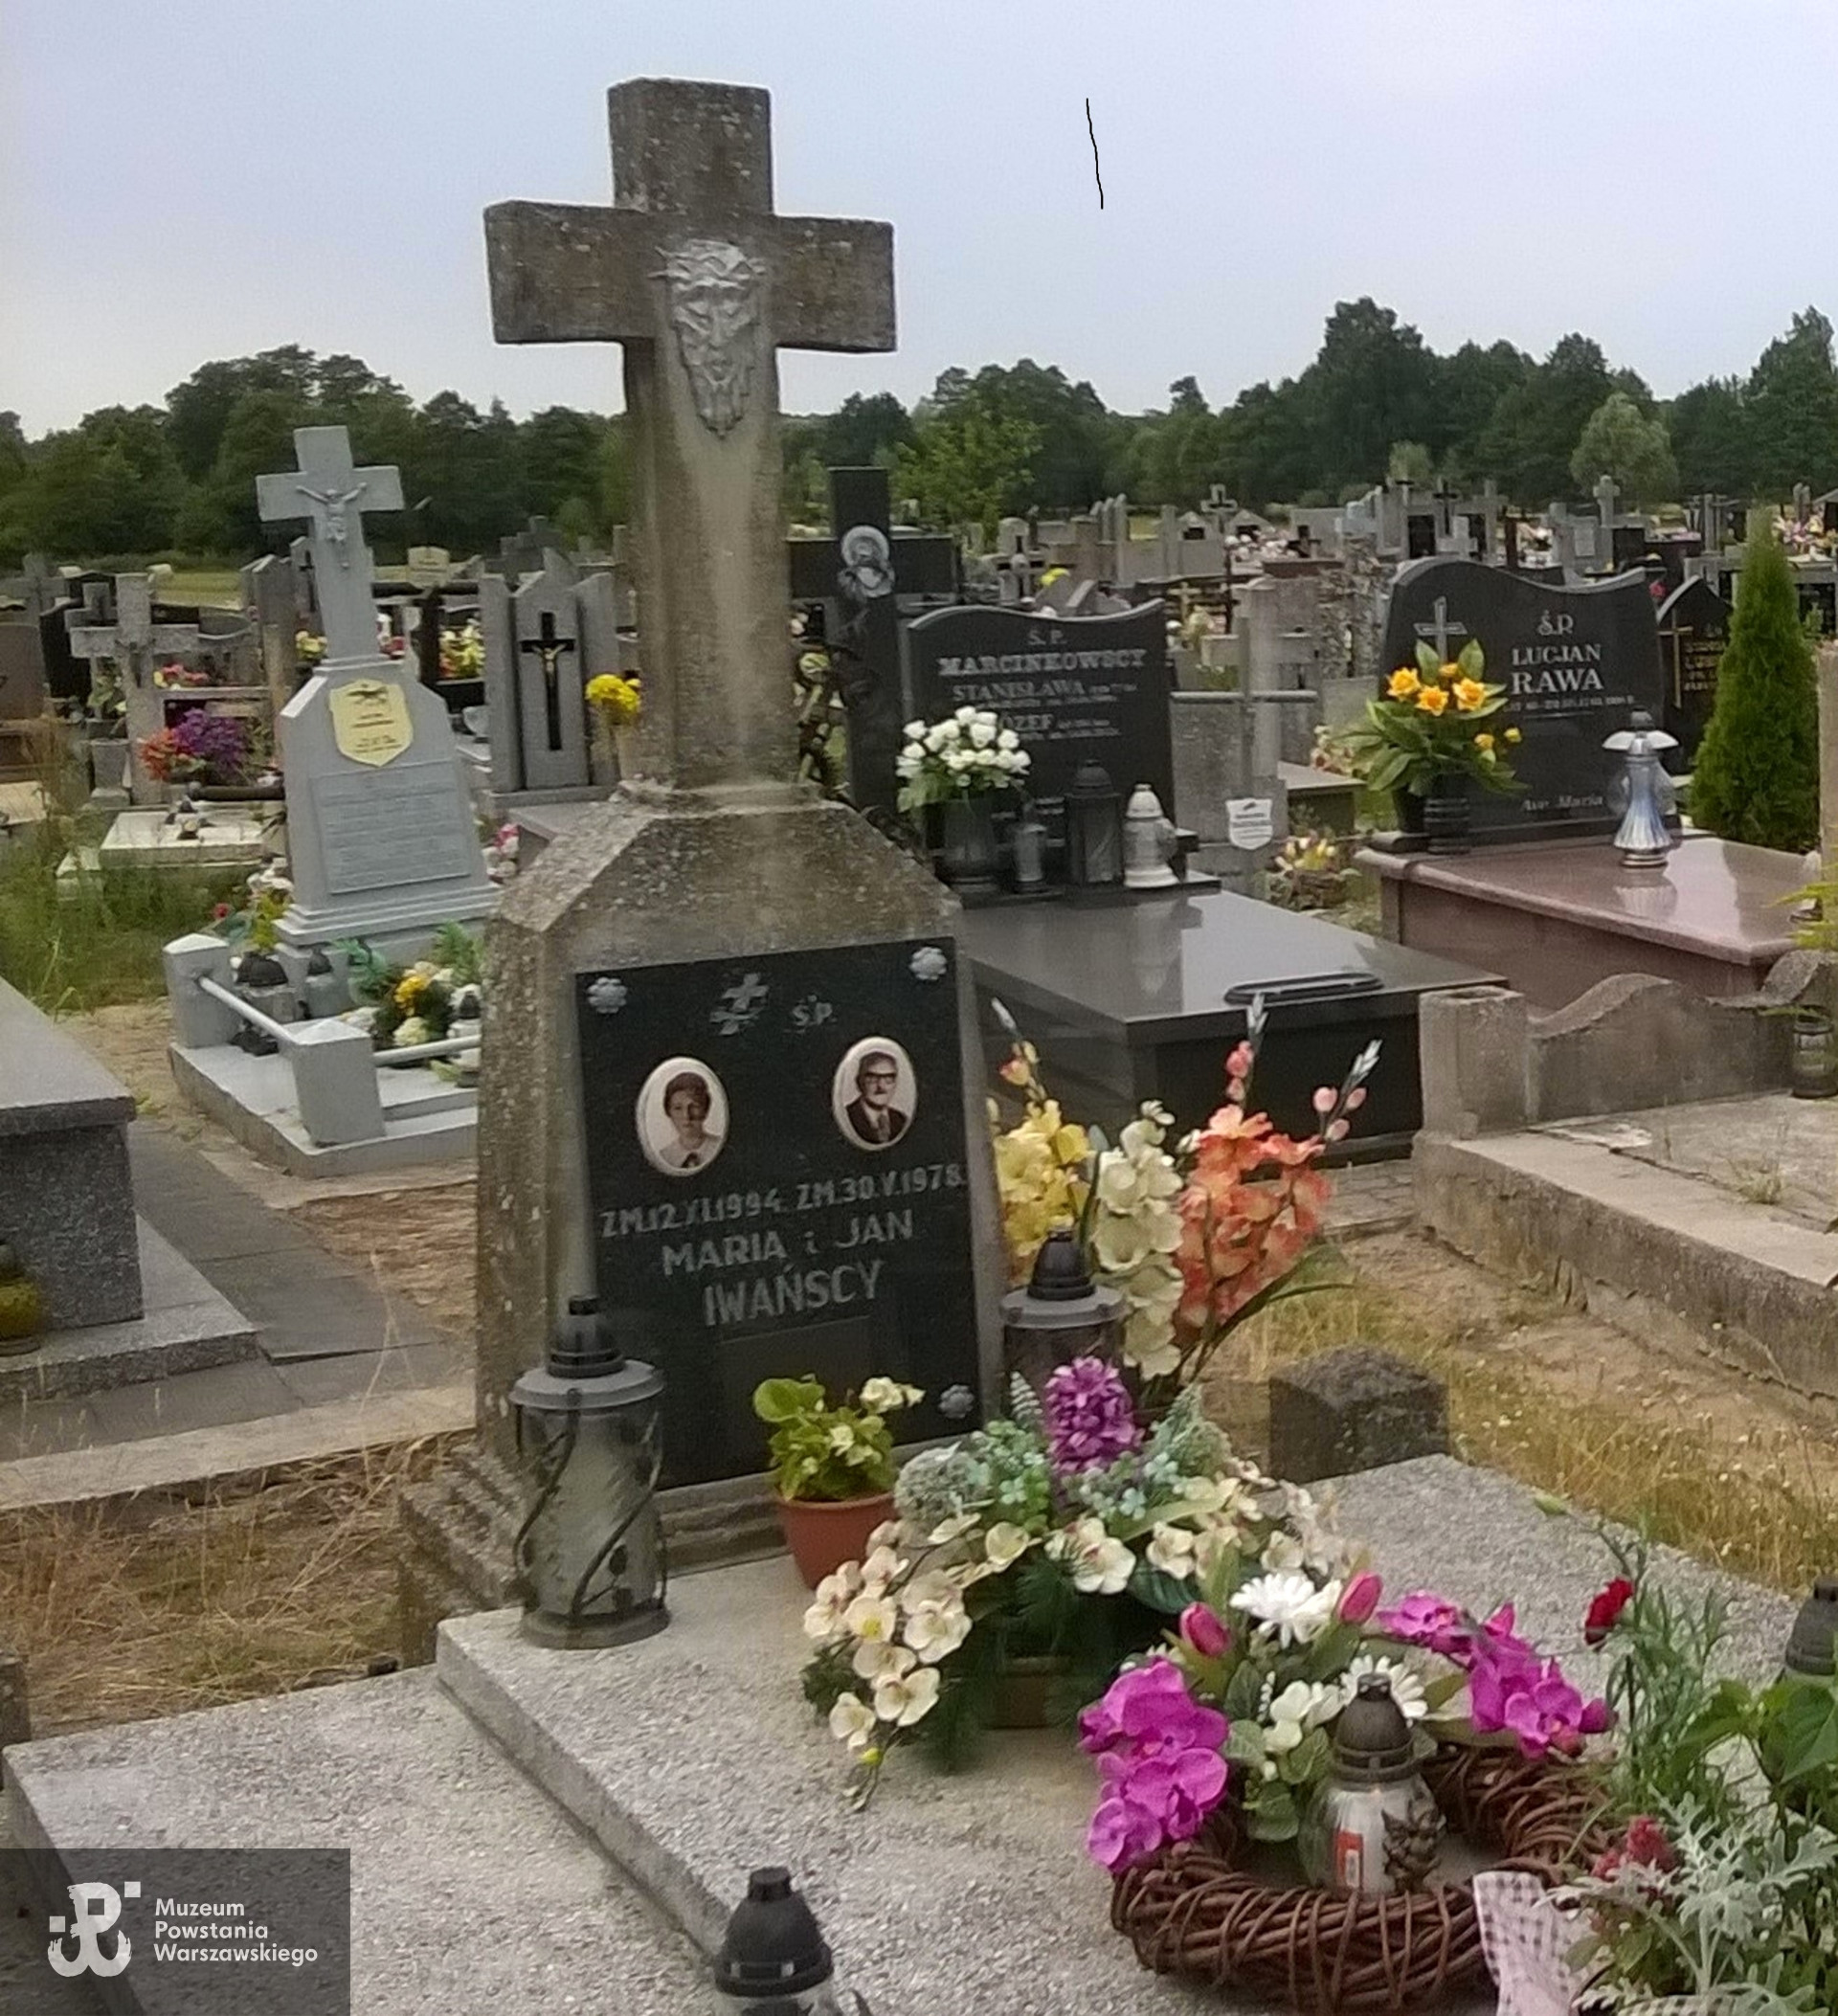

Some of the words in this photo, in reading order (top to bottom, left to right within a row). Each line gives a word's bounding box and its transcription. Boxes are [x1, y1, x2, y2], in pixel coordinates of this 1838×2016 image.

[936, 649, 1147, 676] MARCINKOWSCY
[1512, 643, 1602, 665] LUCJAN
[1511, 668, 1604, 694] RAWA
[662, 1231, 788, 1274] MARIA
[804, 1231, 819, 1254] i
[835, 1209, 913, 1248] JAN
[703, 1259, 884, 1327] IWAŃSCY
